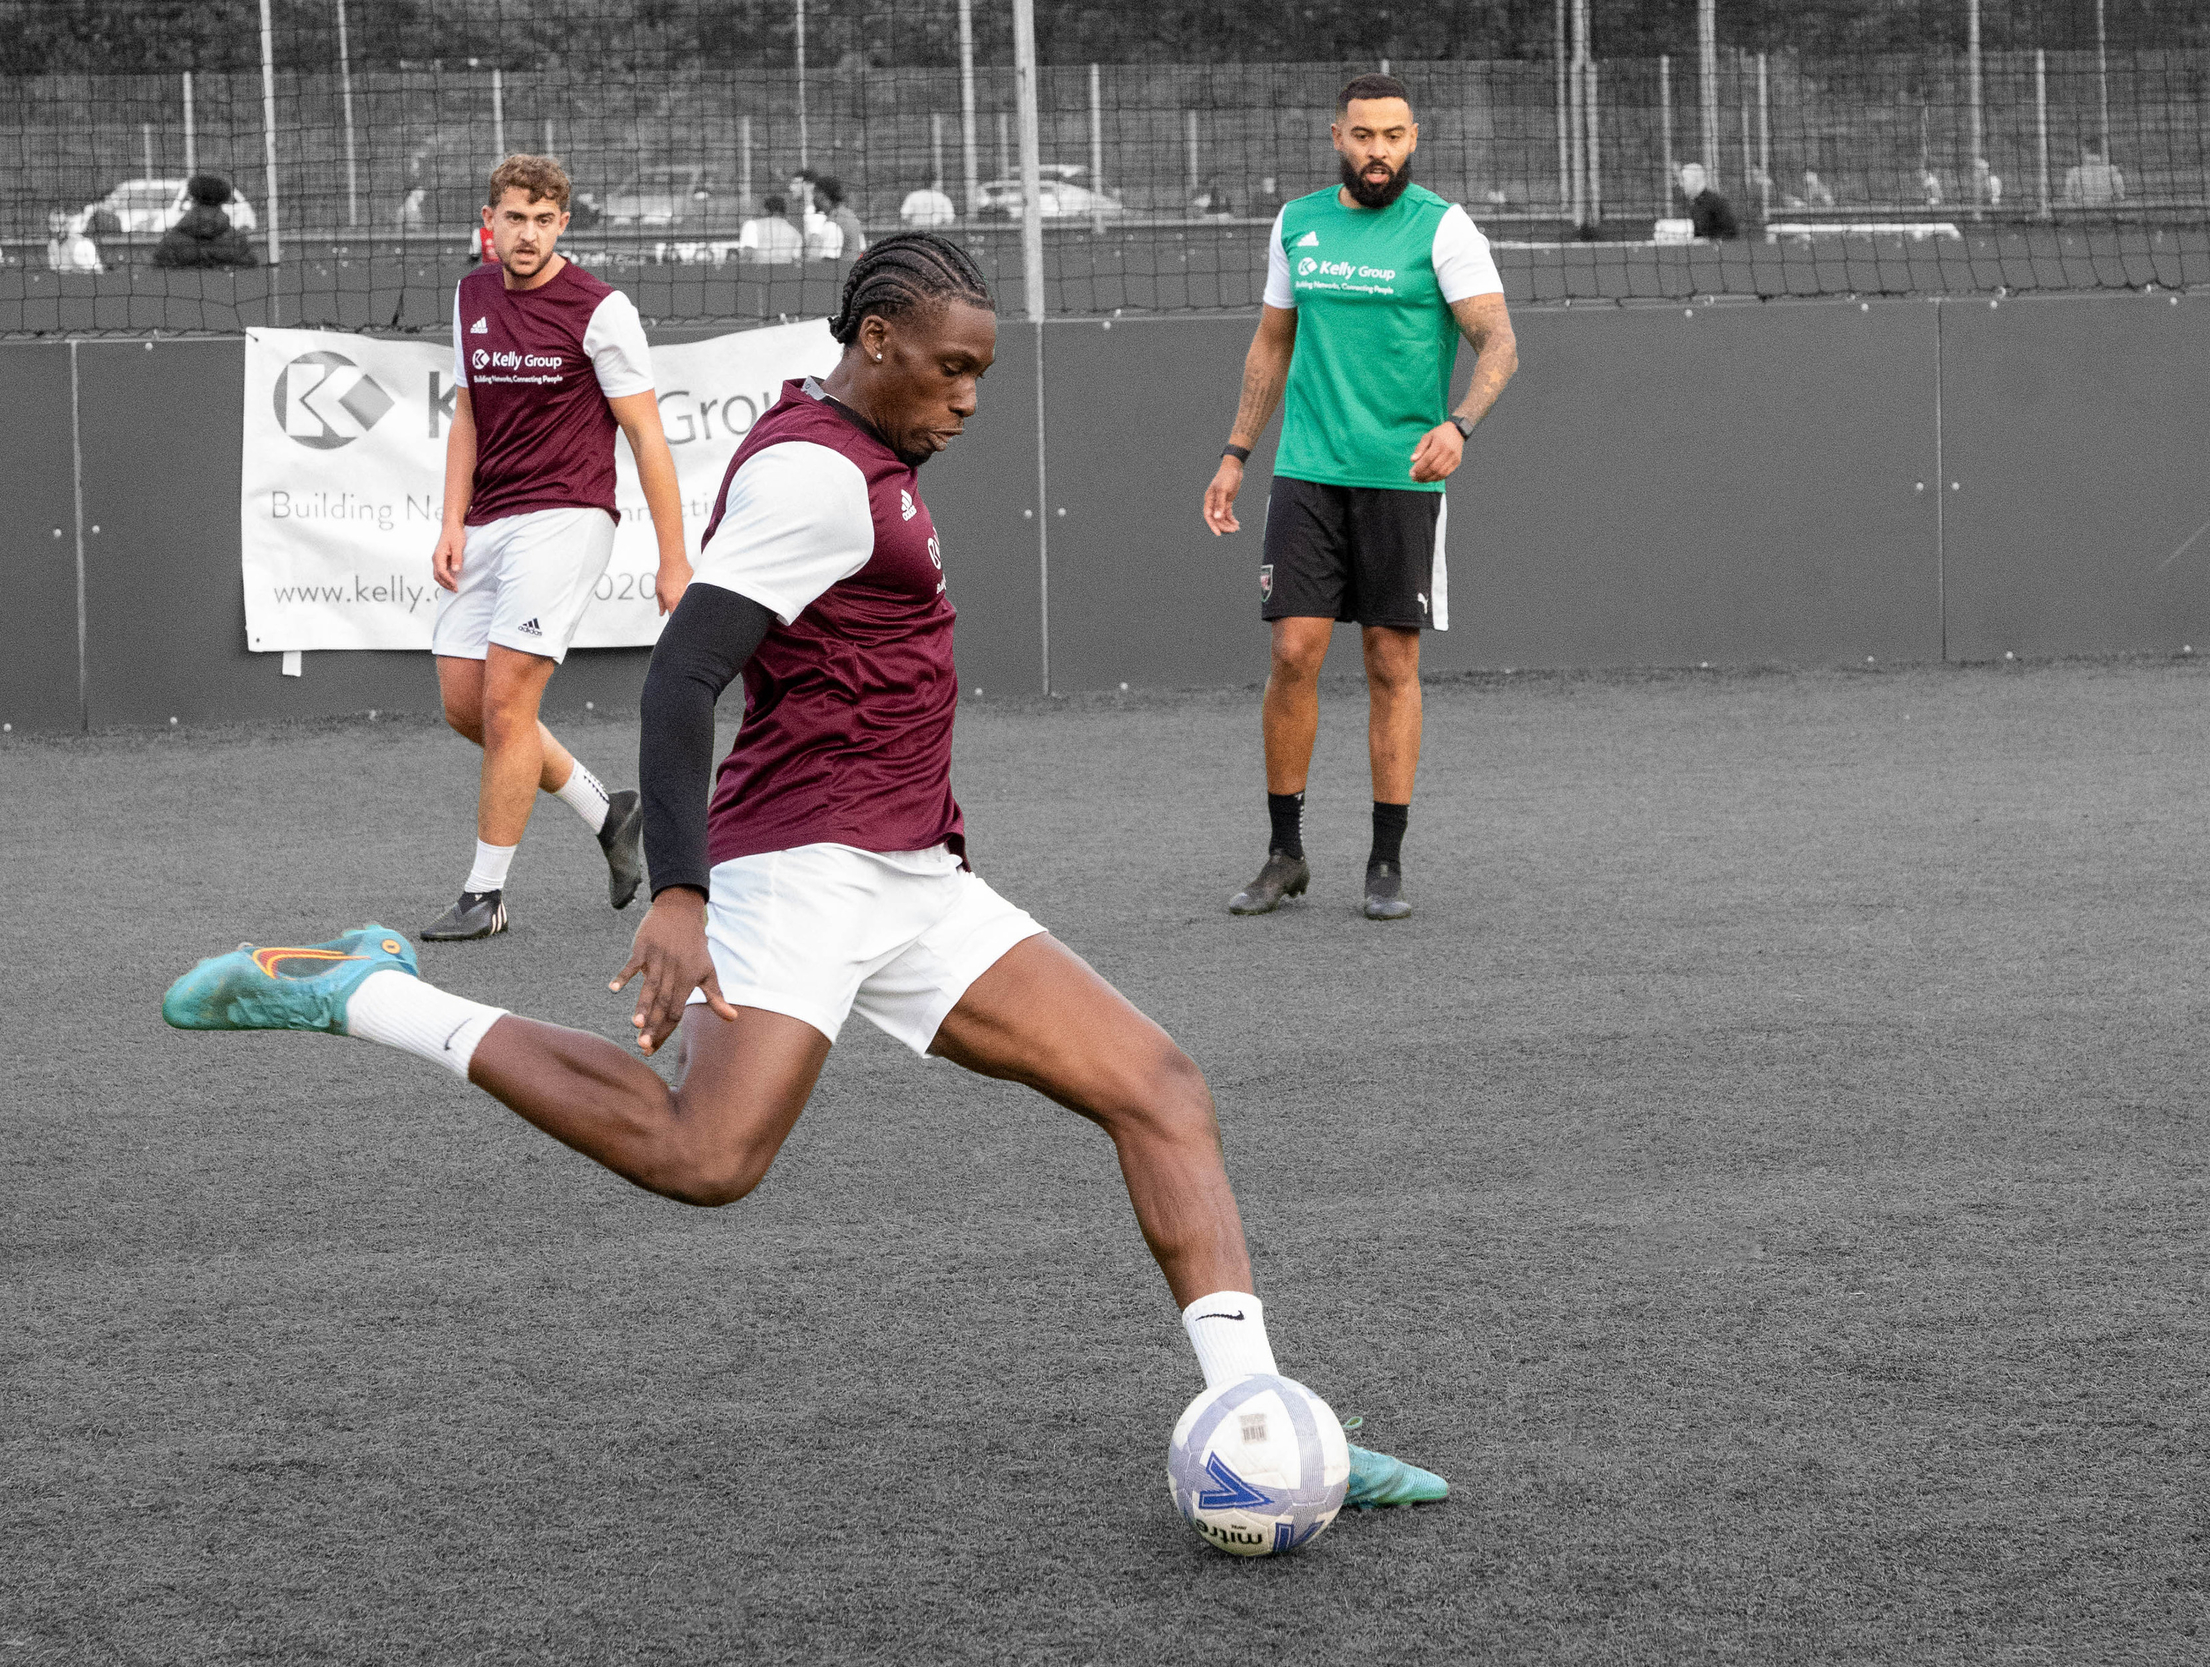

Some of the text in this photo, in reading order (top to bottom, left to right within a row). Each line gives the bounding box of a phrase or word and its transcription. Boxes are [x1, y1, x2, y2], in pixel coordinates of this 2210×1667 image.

[1319, 260, 1356, 280] Kelly
[1358, 265, 1396, 281] Group
[492, 351, 522, 371] Kelly
[524, 354, 562, 370] Group
[271, 490, 394, 531] Building
[518, 626, 542, 636] adidas
[1195, 1518, 1263, 1545] mitre
